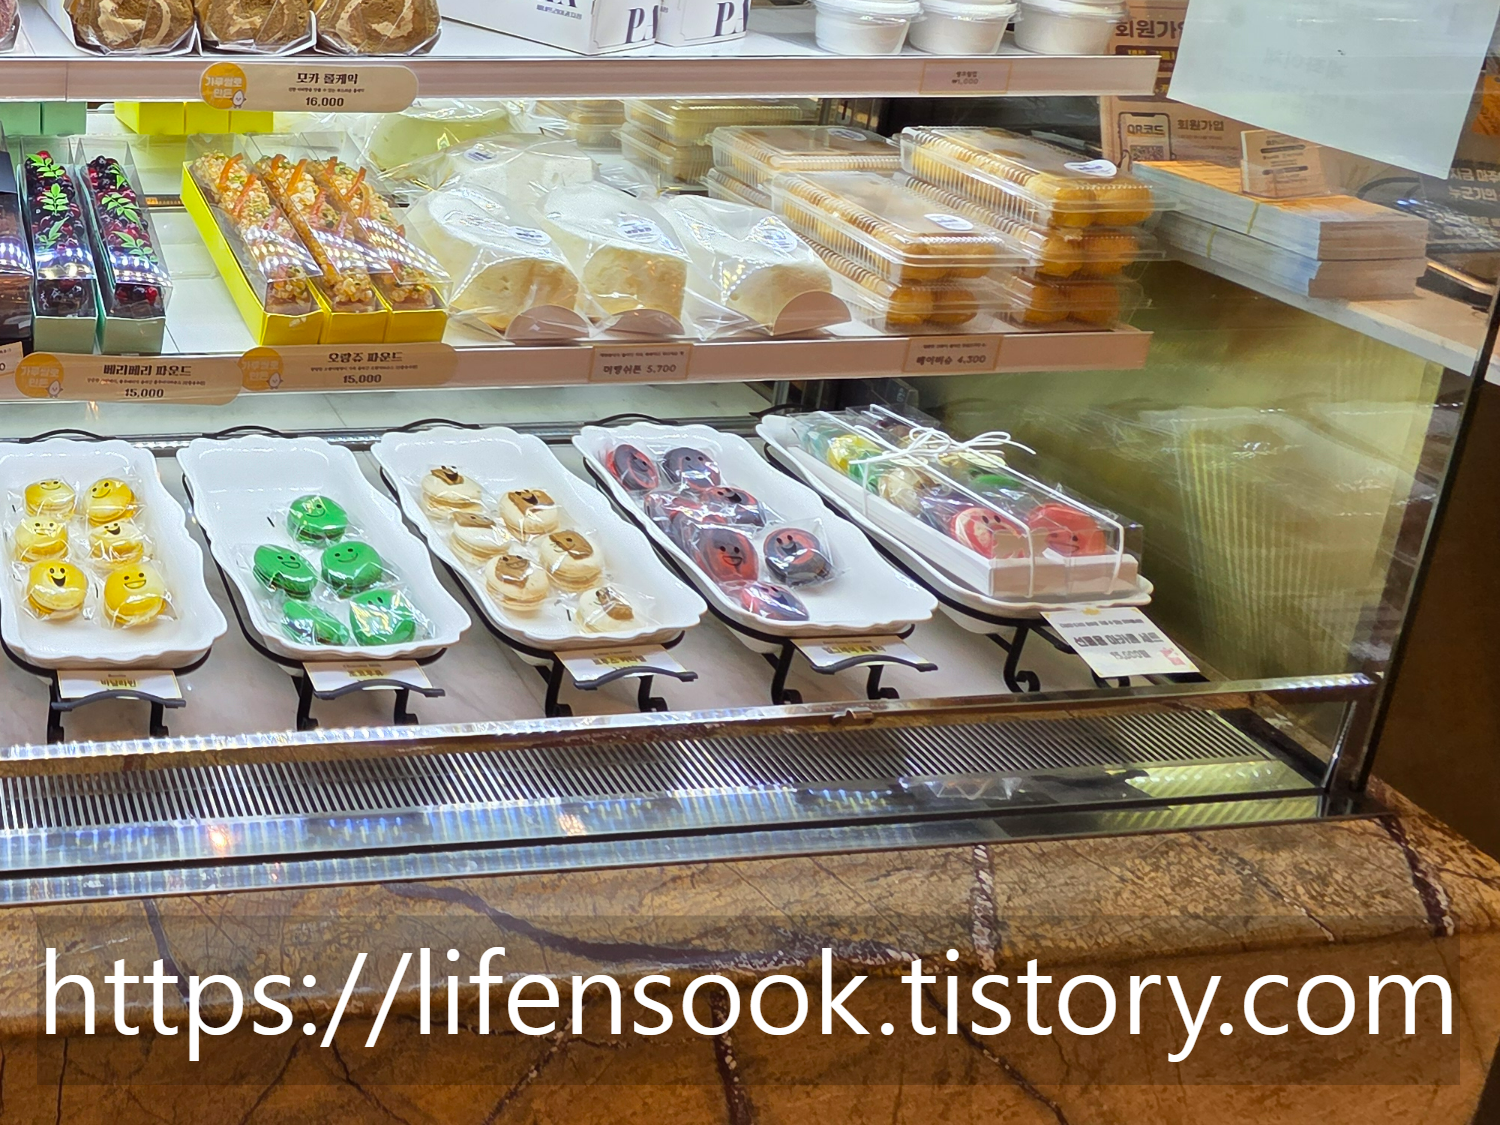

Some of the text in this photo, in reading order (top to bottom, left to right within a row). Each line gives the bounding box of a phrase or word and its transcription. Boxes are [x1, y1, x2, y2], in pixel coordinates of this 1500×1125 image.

[205, 77, 242, 88] 가루쌀로
[296, 73, 359, 85] 모카 롤케익
[213, 88, 232, 99] 만든
[306, 97, 344, 107] 16,000
[1127, 123, 1165, 135] QR코드
[1177, 119, 1224, 132] 회원가입
[367, 351, 403, 363] 파운드
[103, 364, 192, 377] 베리베리 파운드
[343, 374, 382, 384] 15,000
[124, 387, 165, 398] 15,000
